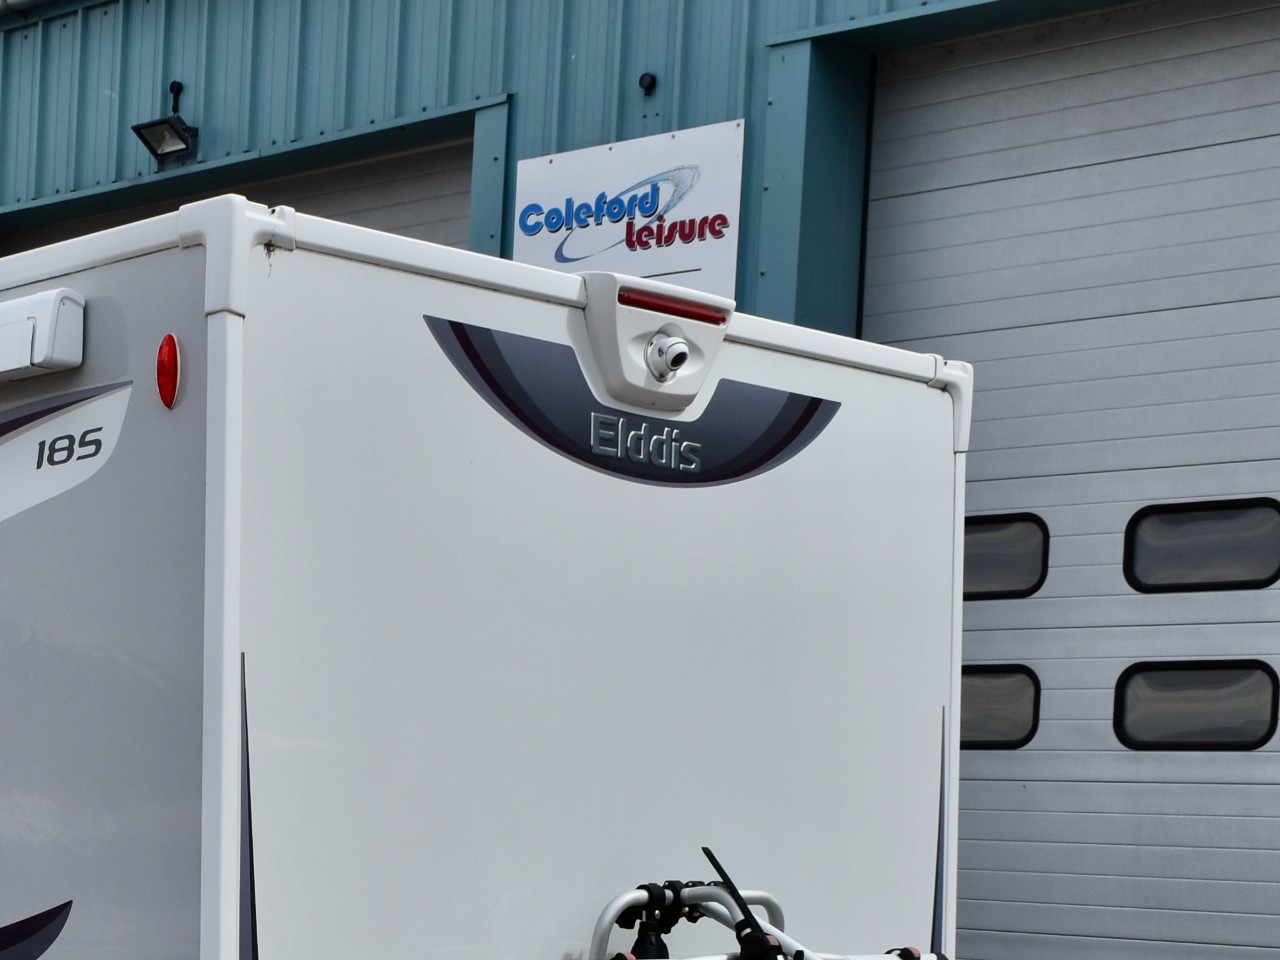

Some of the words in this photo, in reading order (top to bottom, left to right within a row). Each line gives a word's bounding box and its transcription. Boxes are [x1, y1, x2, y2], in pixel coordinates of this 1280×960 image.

[519, 182, 660, 236] Coleford
[36, 426, 103, 470] 185
[590, 412, 702, 474] Elddis
